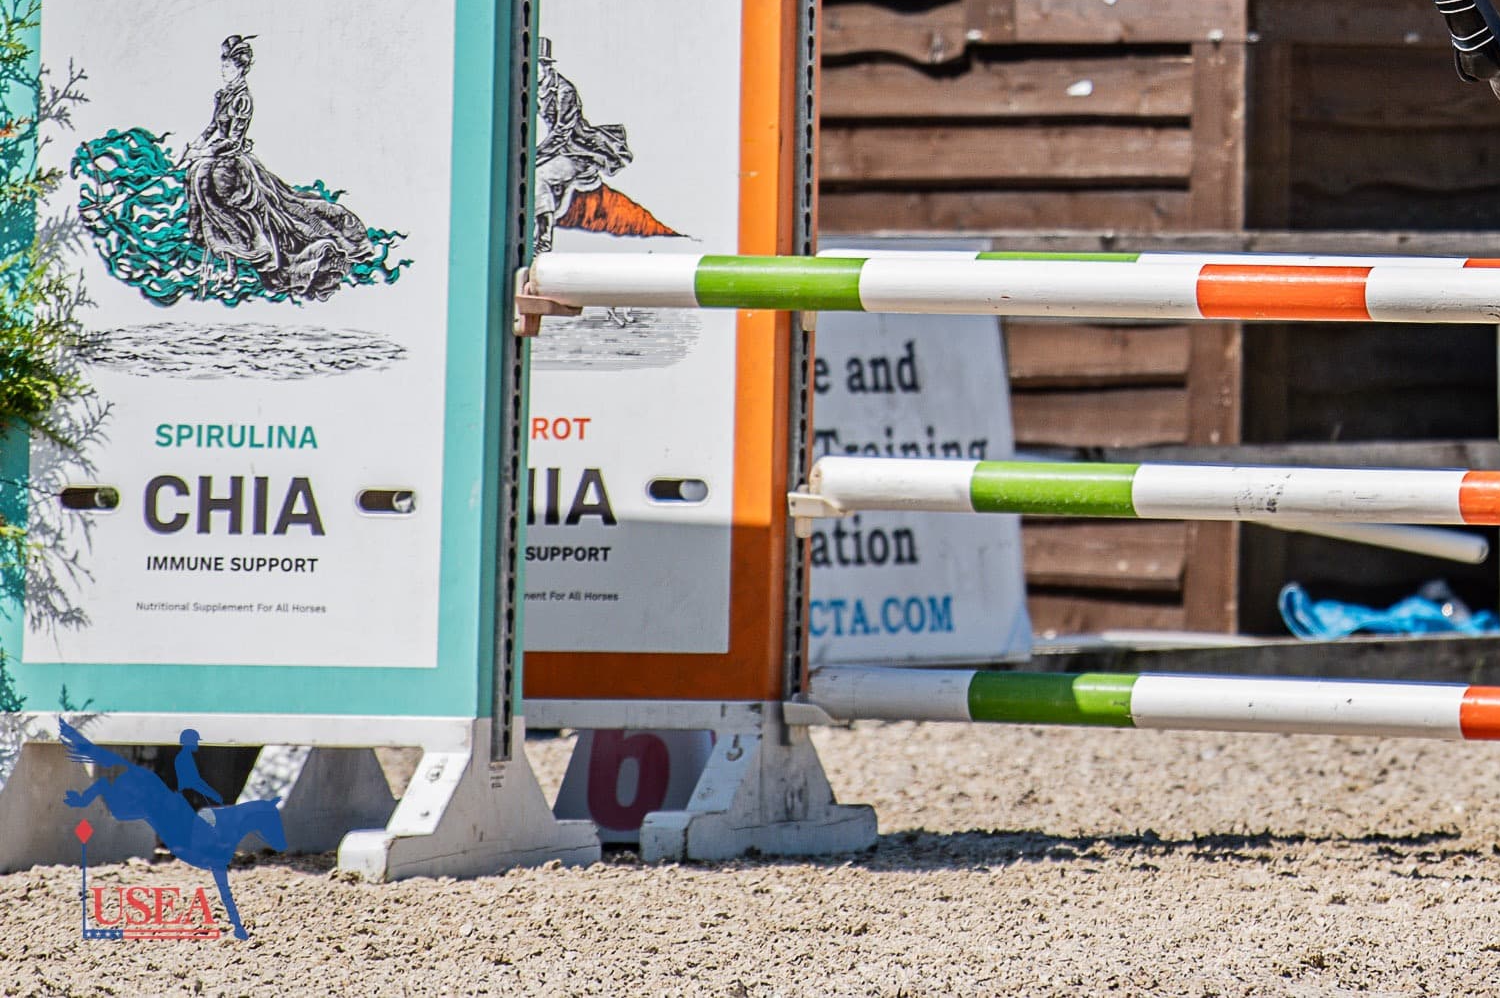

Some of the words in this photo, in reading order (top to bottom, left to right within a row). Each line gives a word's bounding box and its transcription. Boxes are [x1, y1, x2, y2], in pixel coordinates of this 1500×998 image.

[846, 340, 921, 393] and
[155, 424, 318, 449] SPIRULINA
[143, 475, 326, 536] CHIA
[147, 556, 224, 571] IMMUNE
[230, 557, 319, 572] SUPPORT
[525, 546, 611, 562] SUPPORT
[550, 591, 565, 601] For
[568, 591, 581, 601] All
[584, 592, 619, 601] Horses
[136, 602, 190, 612] Nutritional
[193, 602, 254, 614] Supplement
[257, 603, 273, 612] For
[276, 603, 289, 612] All
[292, 604, 327, 613] Horses
[808, 595, 954, 636] CTA.COM
